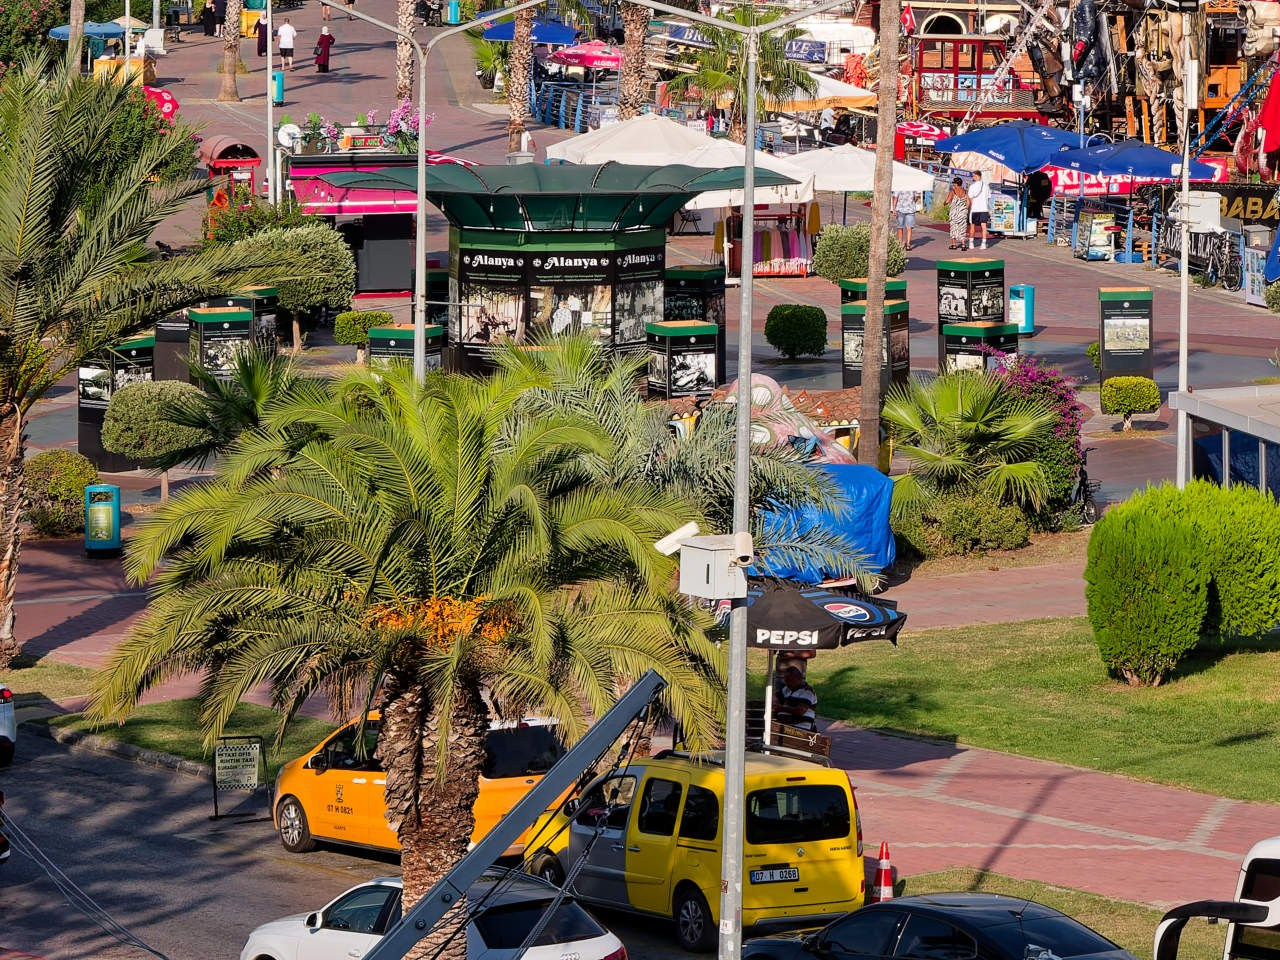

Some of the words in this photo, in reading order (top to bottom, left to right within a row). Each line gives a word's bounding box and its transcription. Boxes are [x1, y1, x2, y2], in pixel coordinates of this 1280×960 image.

[472, 255, 514, 269] Alanya
[544, 256, 598, 269] Alanya
[622, 254, 656, 267] Alanya
[756, 628, 819, 645] PEPSI
[755, 872, 764, 881] 07
[769, 870, 775, 880] H
